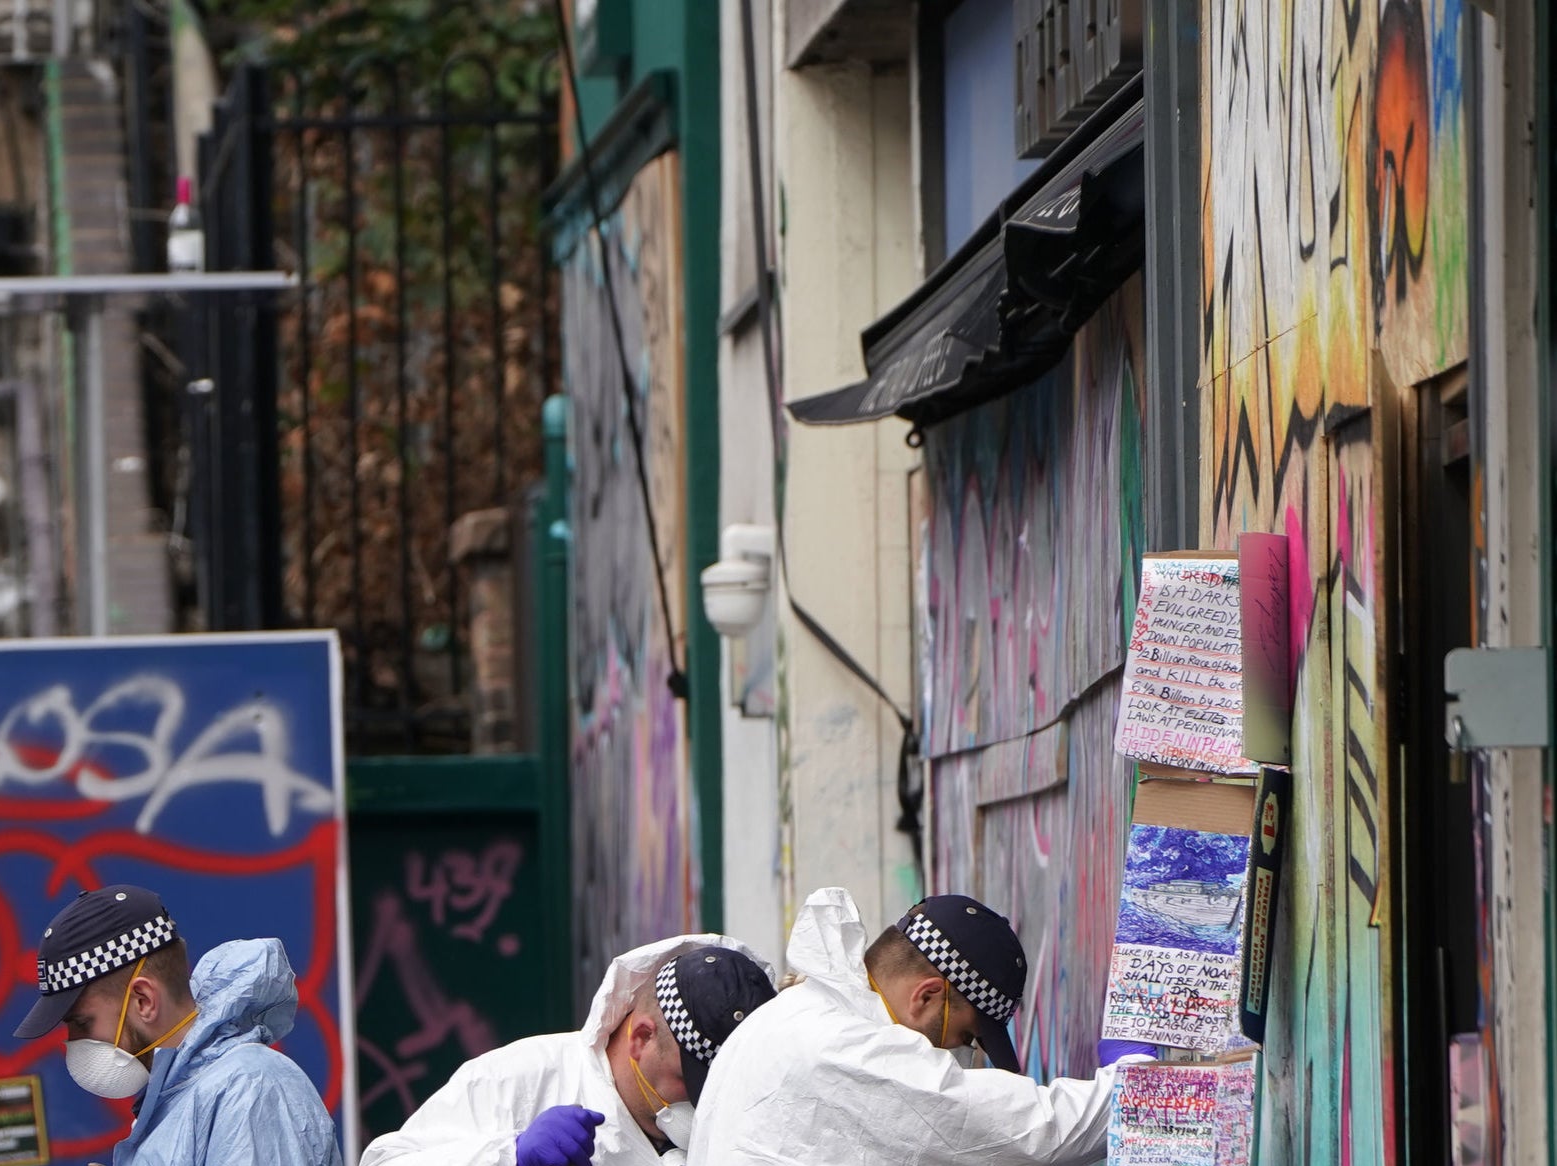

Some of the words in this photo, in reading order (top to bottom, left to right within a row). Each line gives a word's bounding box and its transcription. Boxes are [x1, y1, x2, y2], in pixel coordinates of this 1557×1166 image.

[1159, 584, 1170, 597] IS
[1151, 616, 1200, 635] HUNGER
[1201, 624, 1224, 637] AND
[1142, 630, 1179, 646] DOWN
[1150, 647, 1185, 664] Billion
[1135, 666, 1160, 678] and
[1166, 668, 1203, 686] KILL
[1208, 676, 1225, 689] the
[1131, 680, 1141, 692] 6
[1159, 686, 1195, 704] Billion
[1198, 694, 1213, 710] by
[1128, 698, 1162, 712] LOOK
[1165, 704, 1183, 716] AT
[1127, 710, 1155, 723] LAWS
[1157, 716, 1173, 727] AT
[1123, 723, 1184, 749] HIDDEN
[1187, 732, 1202, 751] IN
[1125, 749, 1158, 762] LOOK
[1130, 958, 1174, 979] DAYS
[1176, 964, 1198, 976] OF
[1123, 971, 1161, 984] SHALL
[1107, 1015, 1129, 1025] THE
[1131, 1016, 1146, 1028] 10
[1104, 1026, 1129, 1038] FIRE
